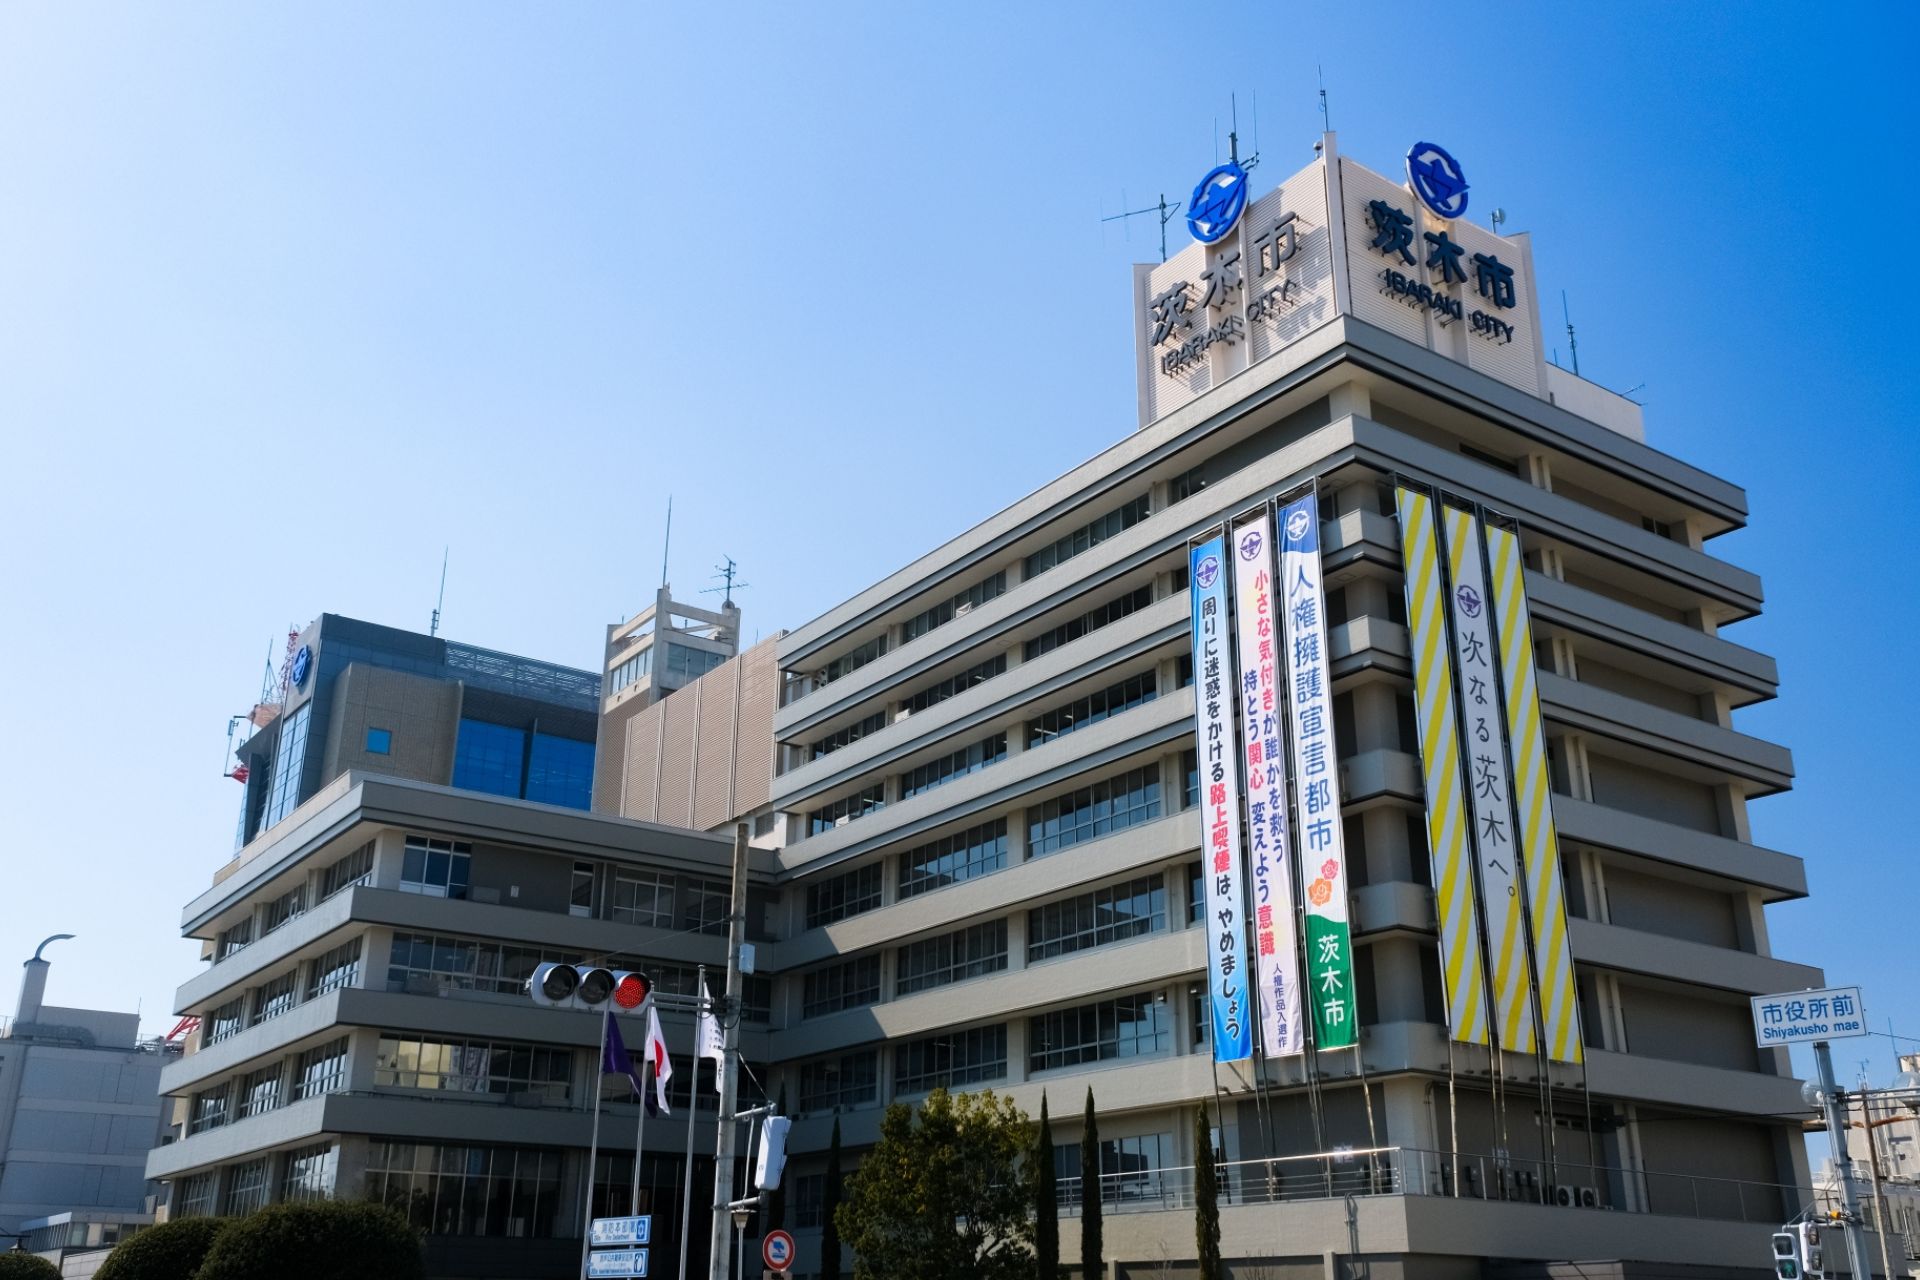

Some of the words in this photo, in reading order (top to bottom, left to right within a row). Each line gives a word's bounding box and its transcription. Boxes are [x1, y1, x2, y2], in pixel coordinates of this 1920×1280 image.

[1150, 211, 1297, 347] 茨木市
[1369, 200, 1516, 310] 茨木市
[1384, 268, 1463, 321] IBARAKI
[1471, 310, 1514, 343] CITY
[1160, 315, 1236, 375] IBARAKI
[1247, 279, 1298, 324] CITY
[1254, 569, 1284, 863] 小さな気付きが誰かを救う
[1290, 564, 1333, 852] 人権擁護宣言都市
[1462, 631, 1516, 897] 次なる茨木へ。
[1201, 596, 1240, 1040] 周りに迷惑をかける路上喫煙は、やめましょう
[1272, 963, 1288, 1048] 人権作品入選作
[1317, 934, 1345, 1027] 茨木市
[1761, 994, 1855, 1024] 市役所前
[1763, 1024, 1829, 1039] Shiyakusho
[1833, 1021, 1860, 1033] mae
